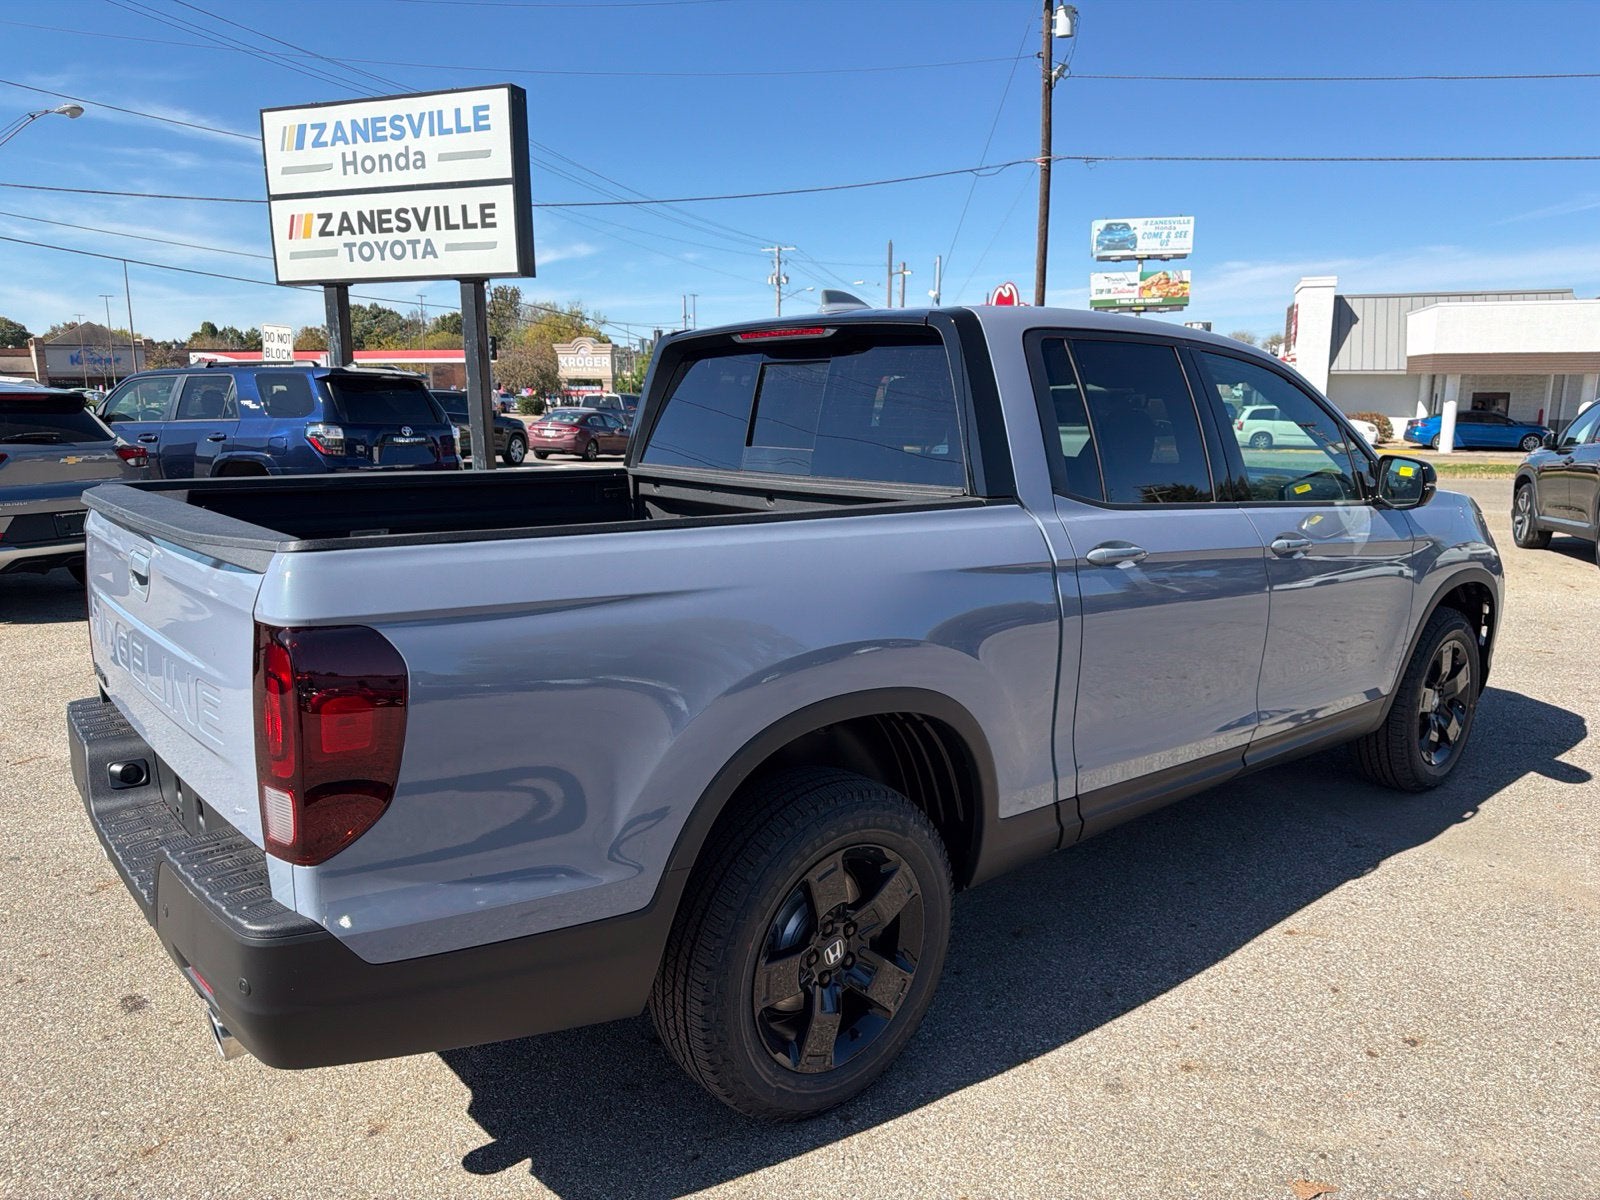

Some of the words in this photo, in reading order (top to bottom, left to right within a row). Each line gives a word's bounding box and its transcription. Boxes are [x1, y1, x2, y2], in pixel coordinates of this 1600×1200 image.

[311, 104, 491, 148] ZANESVILLE
[341, 146, 426, 176] Honda
[317, 203, 498, 238] ZANESVILLE
[1141, 231, 1164, 240] COME
[1174, 230, 1189, 239] SEE
[343, 238, 439, 263] TOYOTA
[264, 331, 275, 343] DO
[277, 332, 291, 344] NOT
[265, 348, 292, 360] BLOCK
[560, 356, 610, 367] KROGER
[92, 594, 225, 746] RIDGELINE
